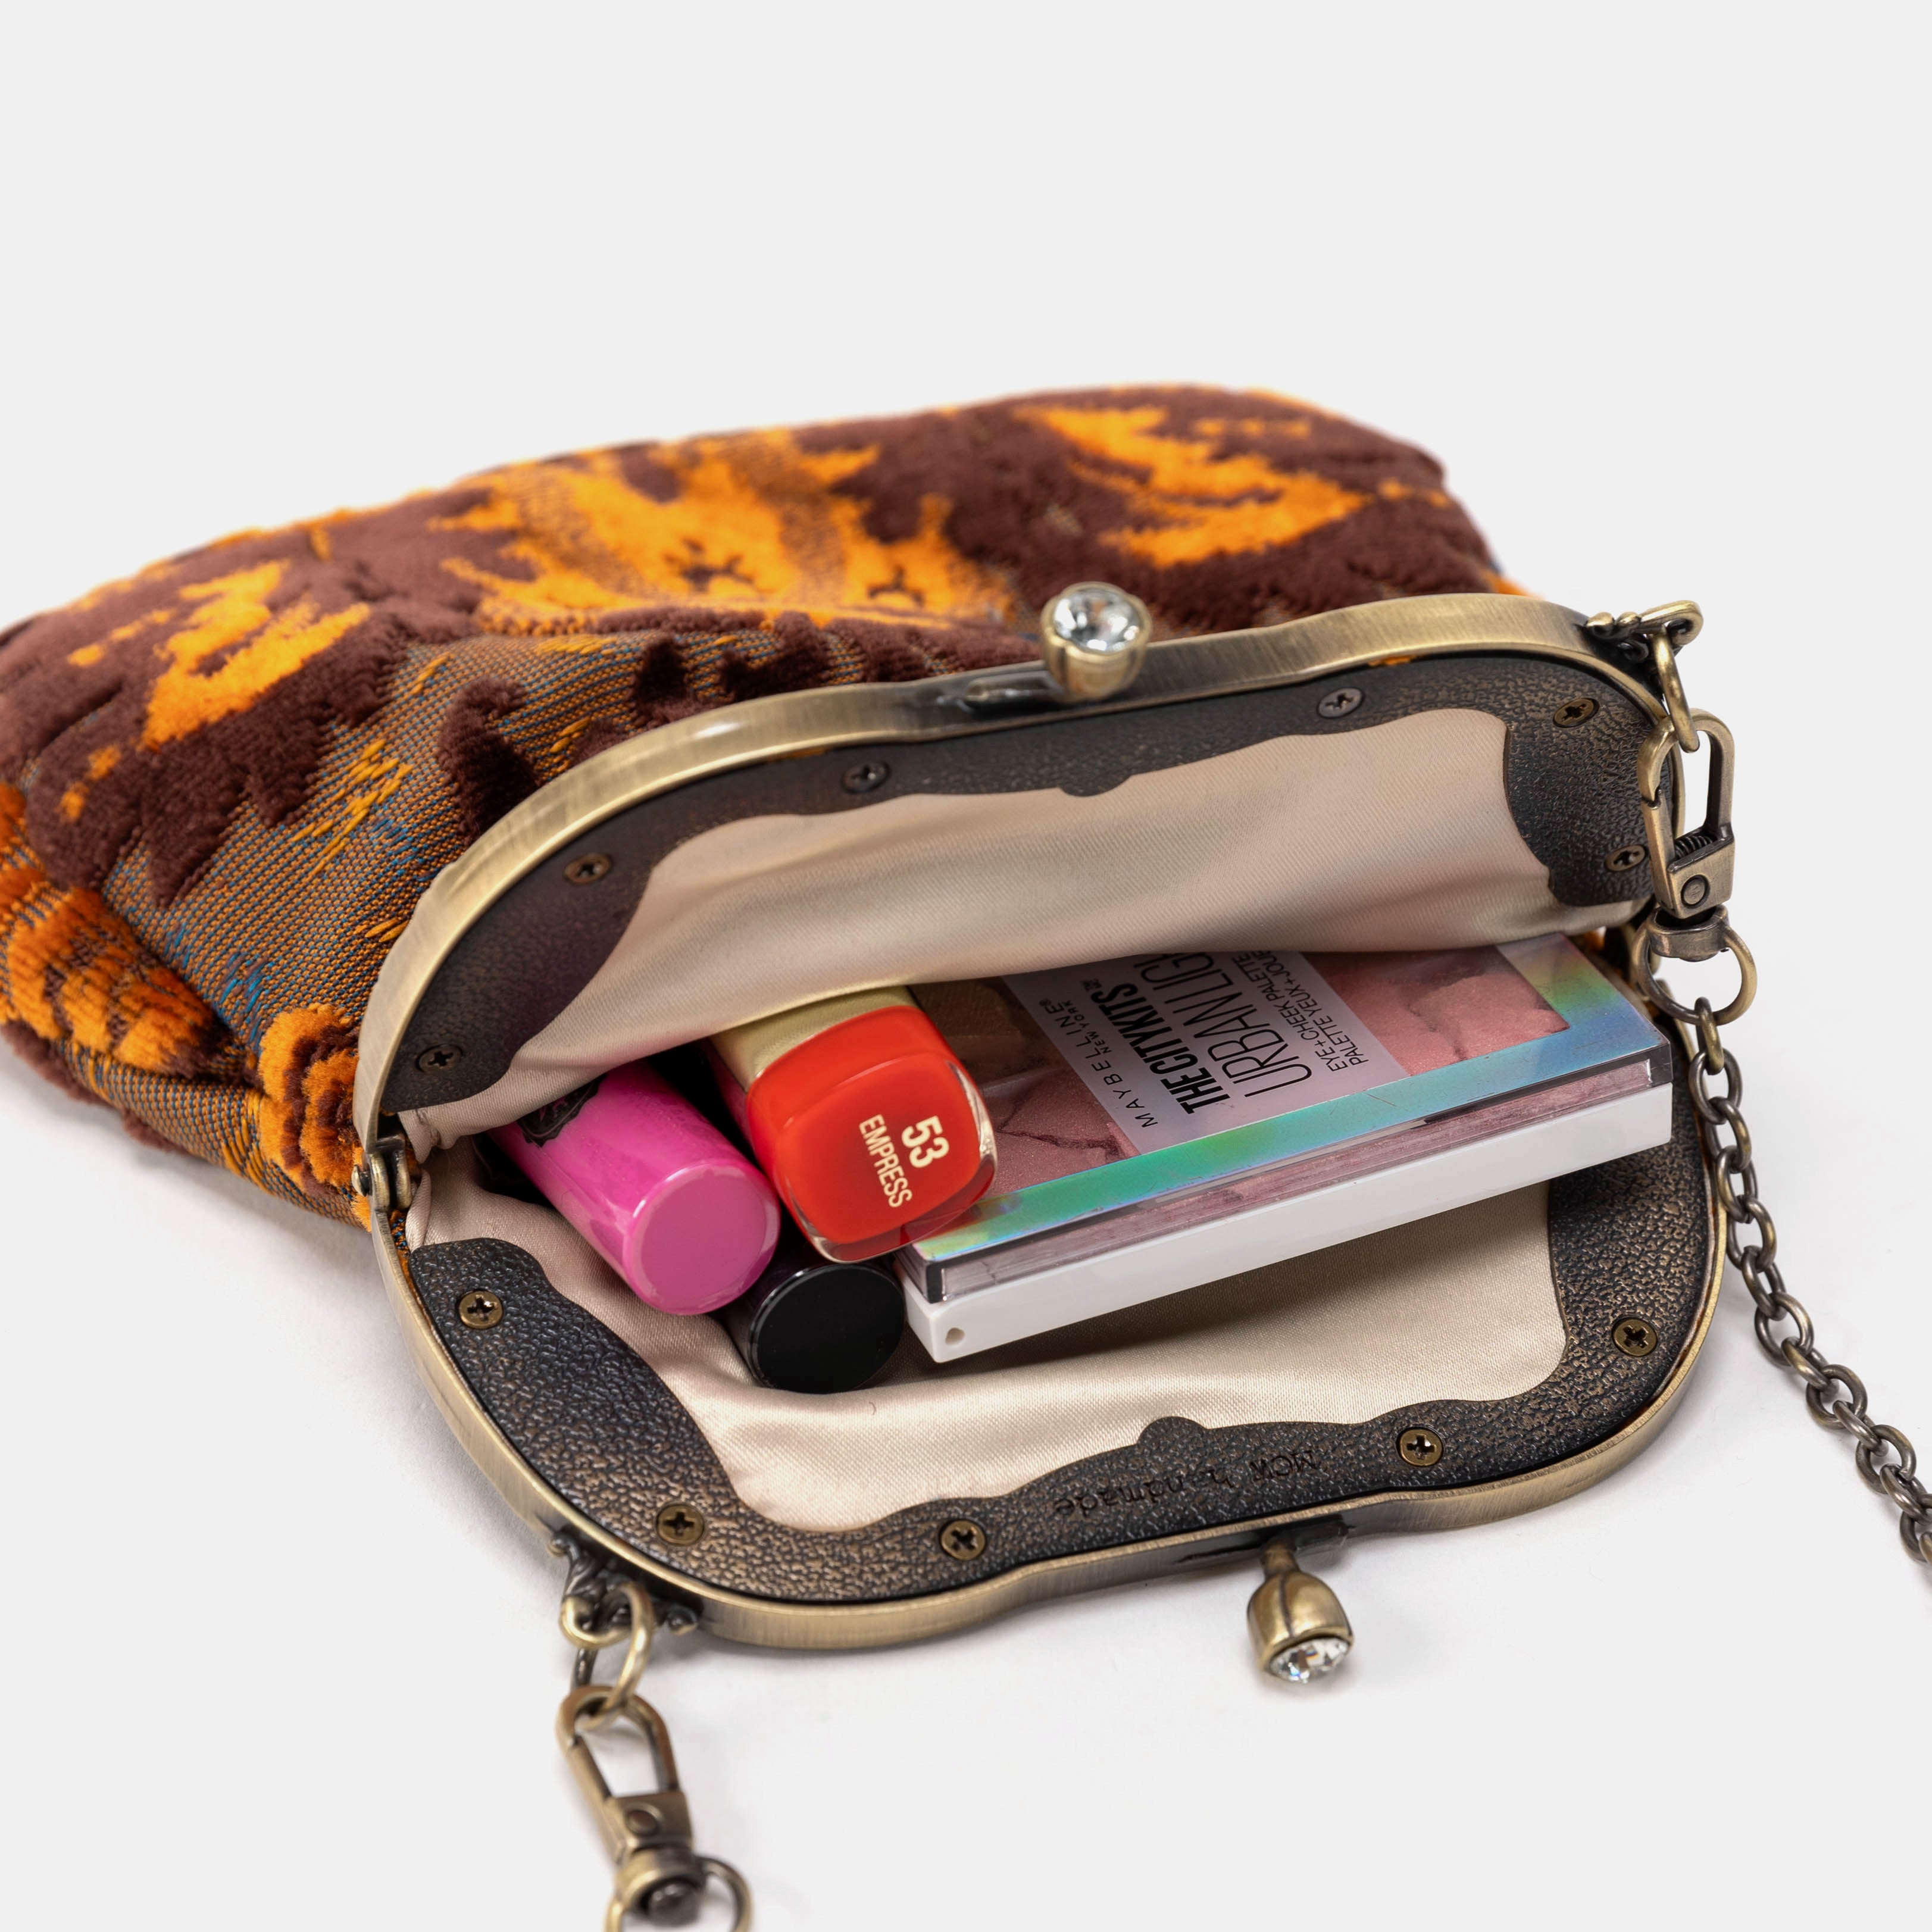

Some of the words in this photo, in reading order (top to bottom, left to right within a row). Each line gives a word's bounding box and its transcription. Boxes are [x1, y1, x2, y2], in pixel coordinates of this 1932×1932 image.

[1231, 953, 1284, 1002] PALETTE
[1062, 1000, 1089, 1028] YORK
[1087, 1031, 1112, 1053] NEW
[1313, 1015, 1369, 1066] PALETTE
[859, 1114, 912, 1207] EMPRESS
[901, 1115, 949, 1168] 53
